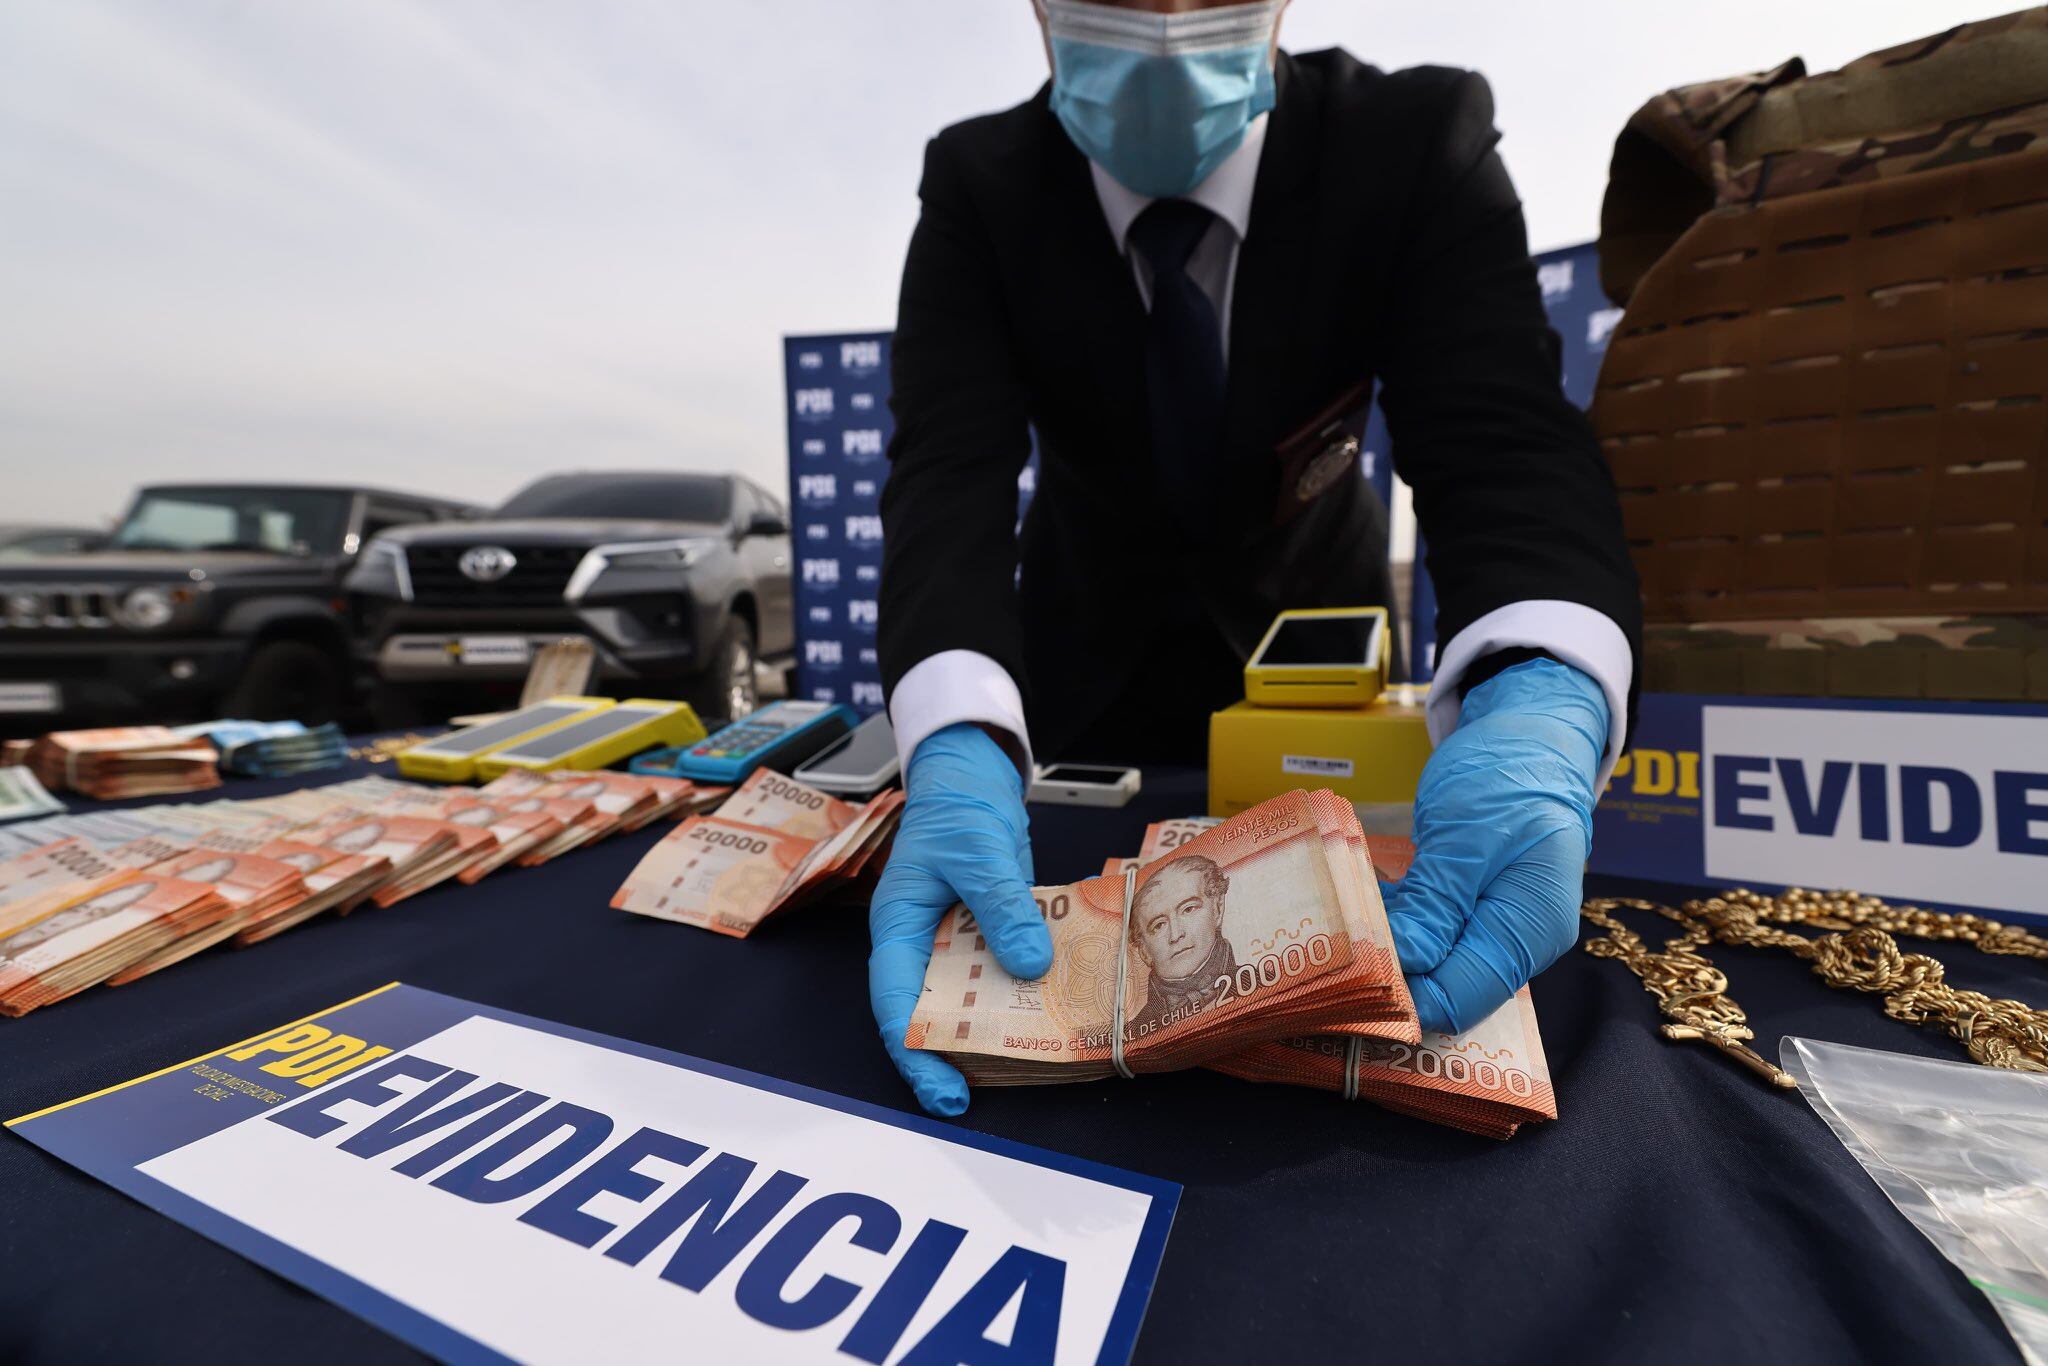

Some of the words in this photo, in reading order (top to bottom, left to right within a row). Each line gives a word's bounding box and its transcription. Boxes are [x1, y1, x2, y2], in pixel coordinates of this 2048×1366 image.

[758, 776, 824, 811] 20000
[1713, 754, 2048, 857] EVIDE
[690, 826, 768, 855] 20000
[1216, 818, 1265, 845] VEINTE
[1267, 804, 1296, 822] MIL
[1252, 816, 1299, 843] PESOS
[1214, 933, 1333, 1008] 20000
[1003, 1036, 1062, 1051] BANCO
[1140, 1019, 1157, 1037] DE
[1161, 1000, 1202, 1026] CHILE
[225, 1023, 395, 1089] PDI
[1321, 1042, 1371, 1062] CHE
[1388, 1042, 1533, 1098] 20000
[265, 1054, 1068, 1366] EVIDENCIA
